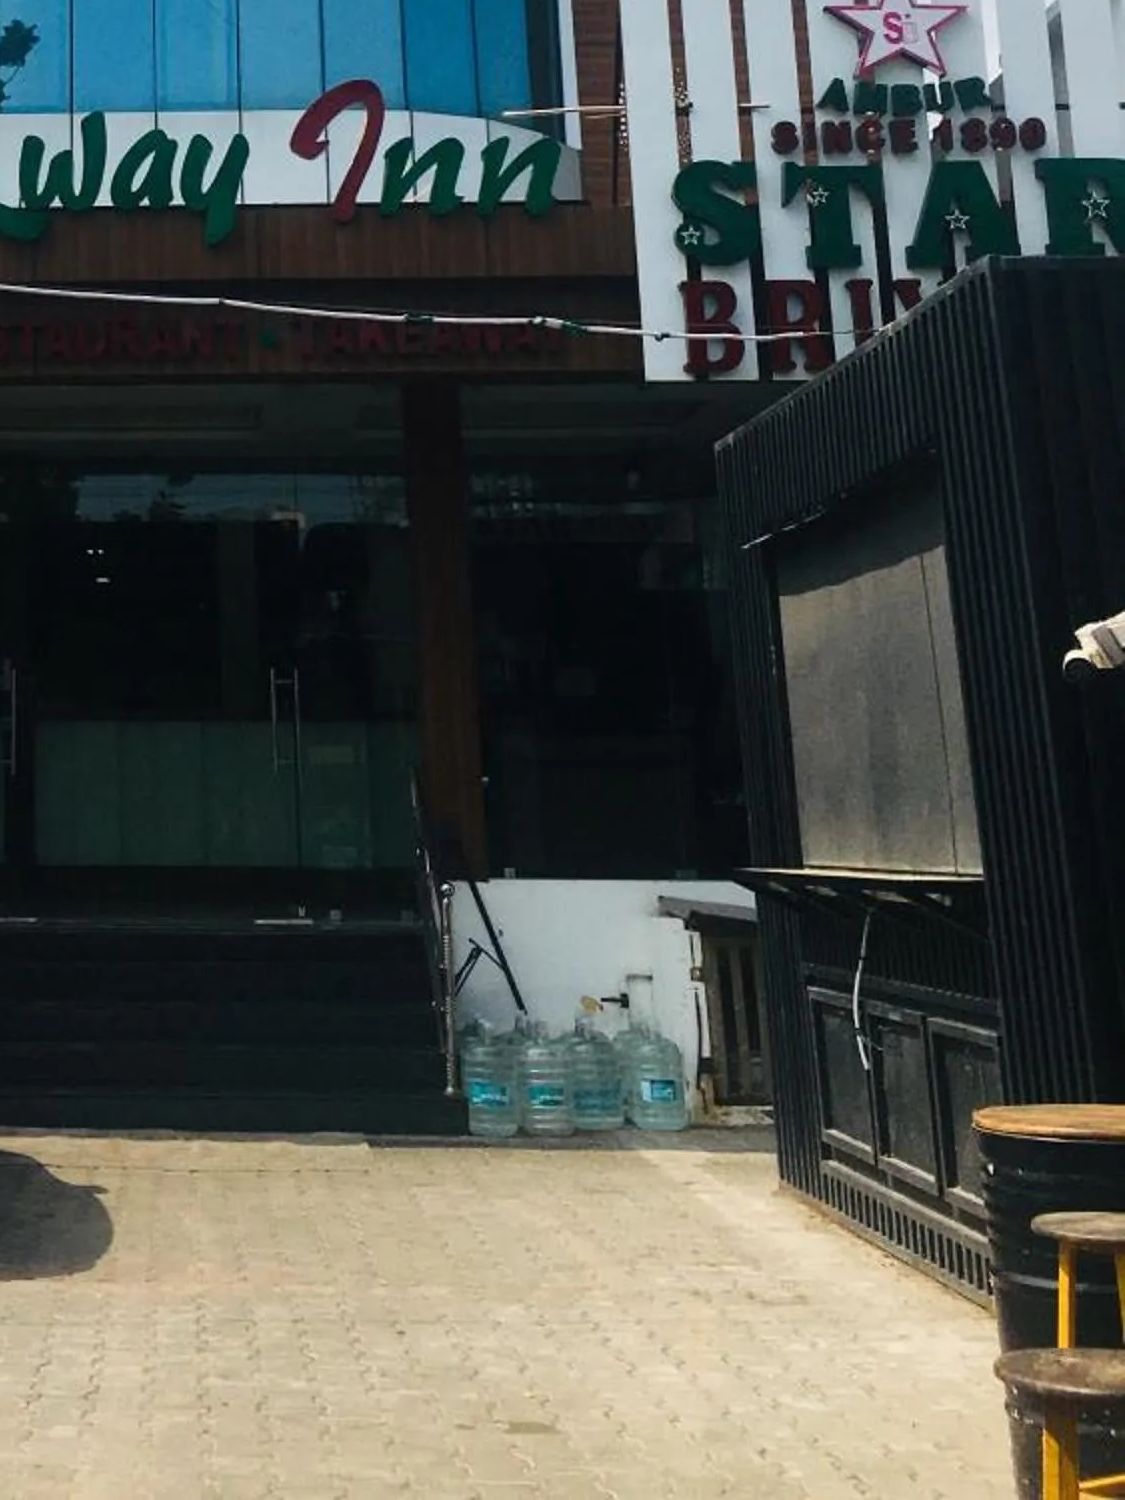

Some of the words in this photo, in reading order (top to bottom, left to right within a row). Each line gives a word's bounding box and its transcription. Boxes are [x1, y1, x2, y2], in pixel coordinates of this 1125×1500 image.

[289, 78, 562, 223] Inn
[770, 116, 918, 155] SINCE
[671, 157, 1125, 270] STAR
[678, 278, 924, 376] BRI
